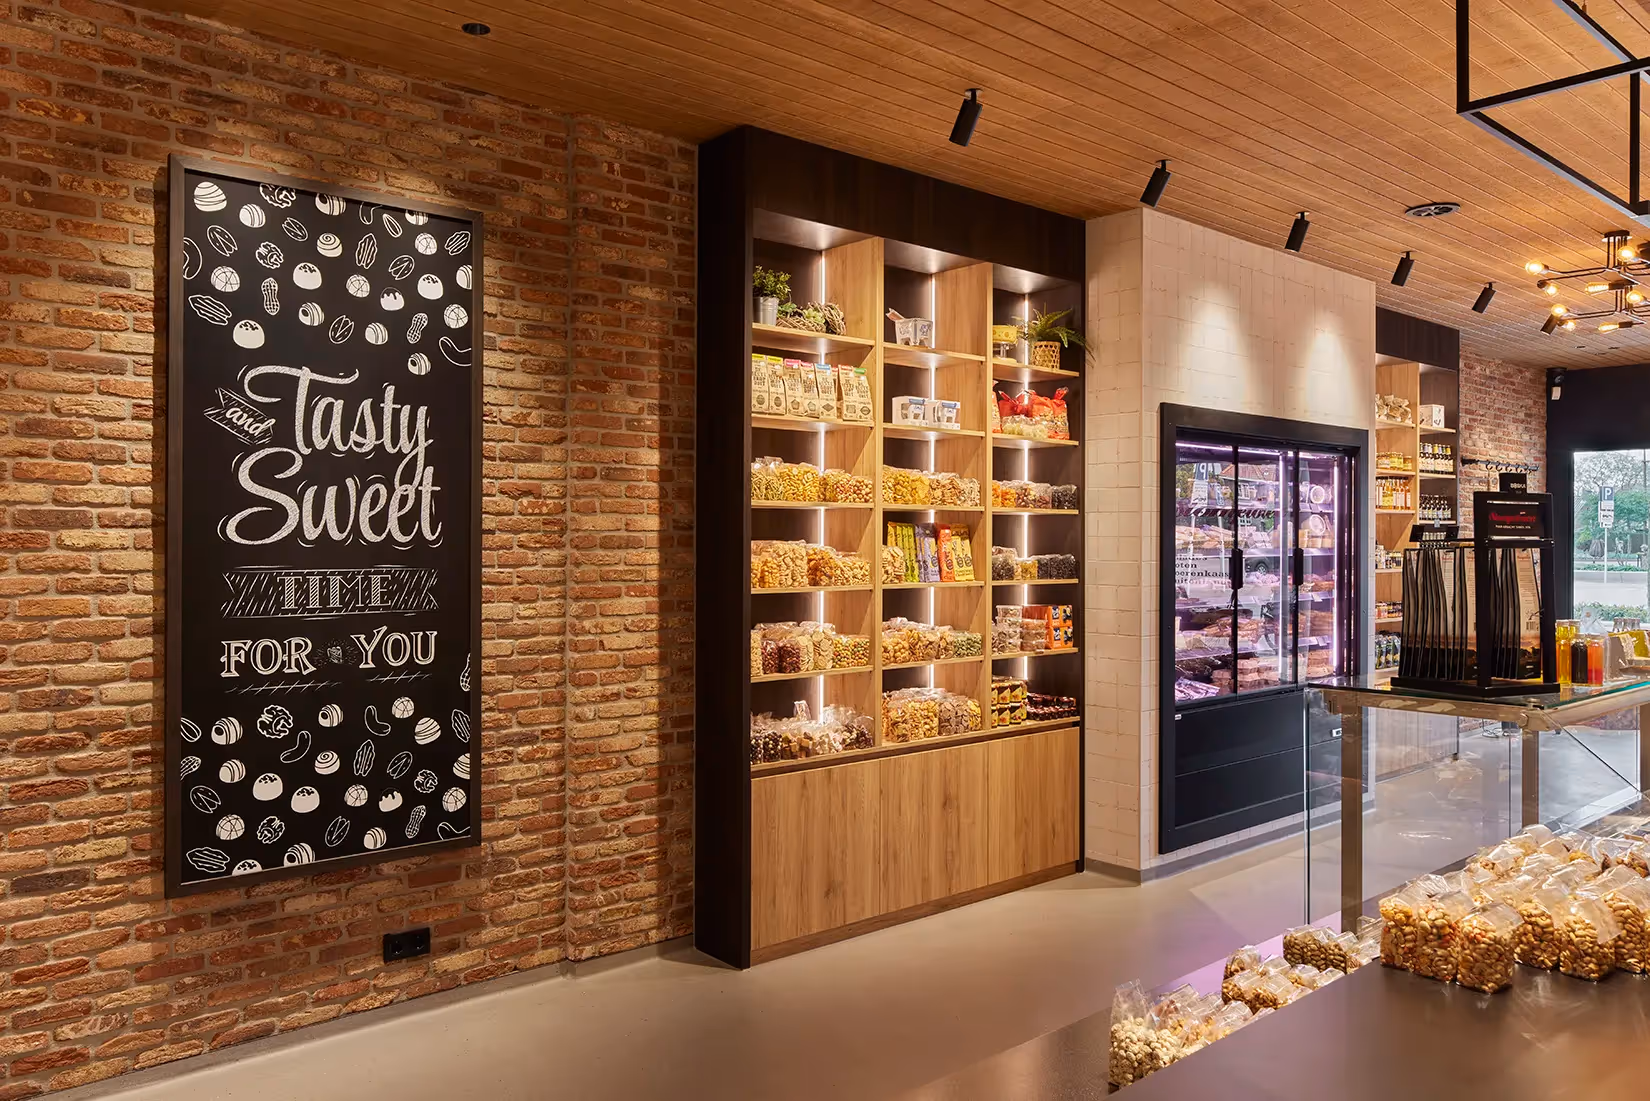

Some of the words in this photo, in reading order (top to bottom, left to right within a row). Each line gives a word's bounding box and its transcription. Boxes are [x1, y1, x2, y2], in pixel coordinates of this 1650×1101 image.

[225, 406, 276, 437] and
[244, 365, 433, 490] Tasty
[225, 447, 442, 546] Sweet
[1604, 487, 1612, 499] P
[277, 574, 392, 610] TIME
[220, 636, 317, 678] FOR
[350, 625, 438, 669] YOU
